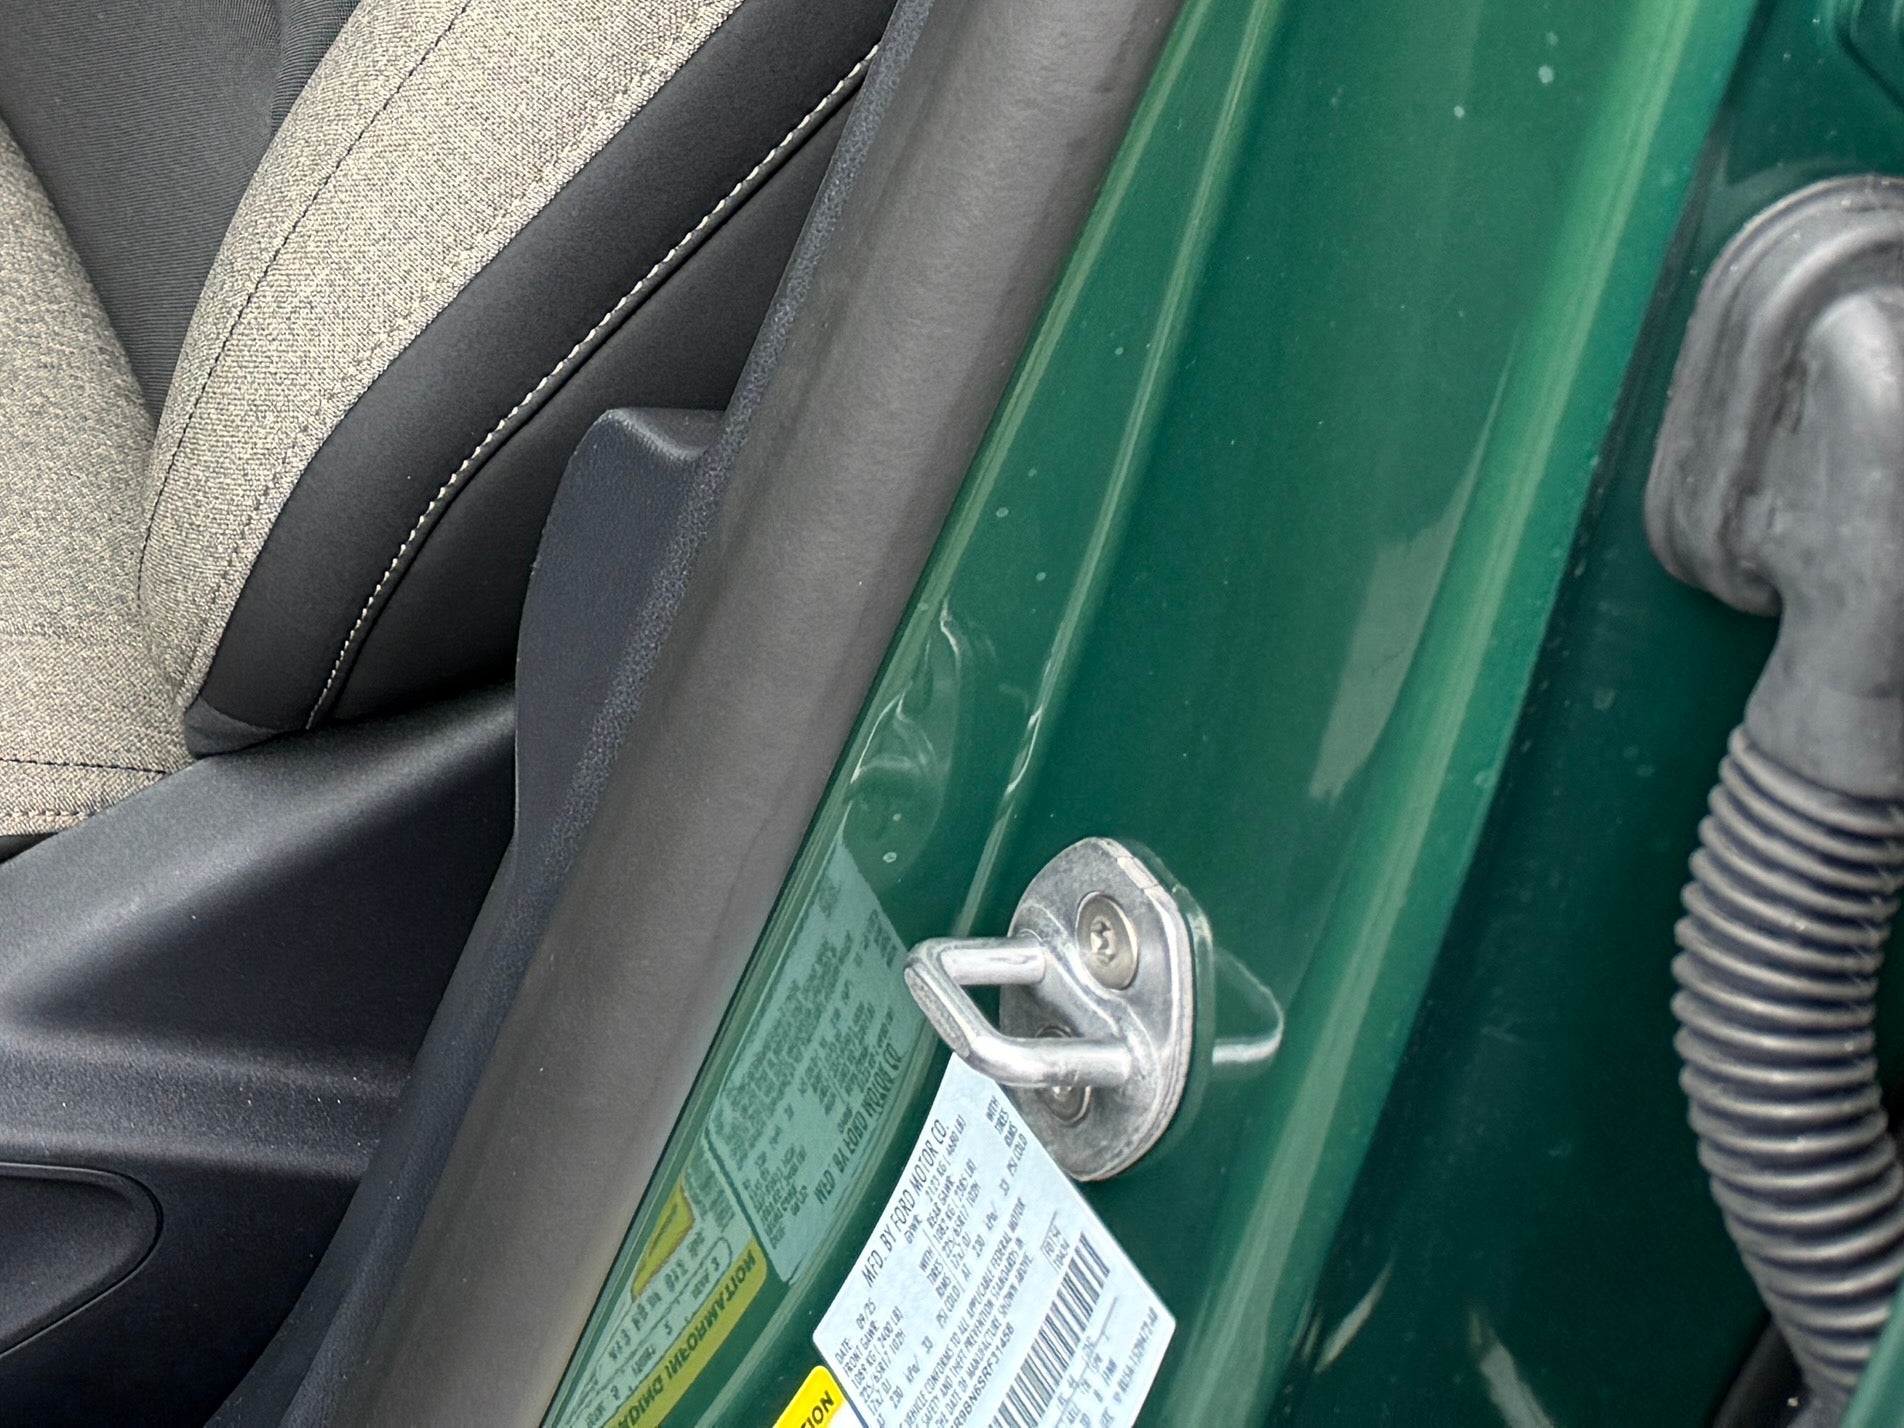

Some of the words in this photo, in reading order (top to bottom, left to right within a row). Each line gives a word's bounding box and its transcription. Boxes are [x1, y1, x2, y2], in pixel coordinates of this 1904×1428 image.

[1012, 1132, 1028, 1162] COLD
[861, 1249, 887, 1288] MFD.
[879, 1223, 897, 1252] BY
[889, 1188, 916, 1232] FORD
[909, 1139, 938, 1196] MOTOR
[930, 1118, 949, 1145] CO.
[923, 1344, 954, 1394] CONFORMS
[966, 1267, 995, 1319] APPLICABLE
[990, 1231, 1012, 1269] FEDERAL
[1007, 1196, 1026, 1233] MOTOR
[943, 1284, 961, 1313] COLD
[855, 1297, 877, 1330] 09/25
[920, 1394, 940, 1428] SAFETY
[939, 1374, 953, 1398] AND
[948, 1347, 968, 1378] THEFT
[963, 1298, 994, 1352] PREVENTION
[990, 1249, 1019, 1300] STANDARDS
[944, 1388, 962, 1416] DATE
[965, 1315, 1002, 1380] MANUFACTURE
[997, 1283, 1018, 1318] SHOWN
[842, 1344, 863, 1377] FRONT
[888, 1384, 904, 1409] 230
